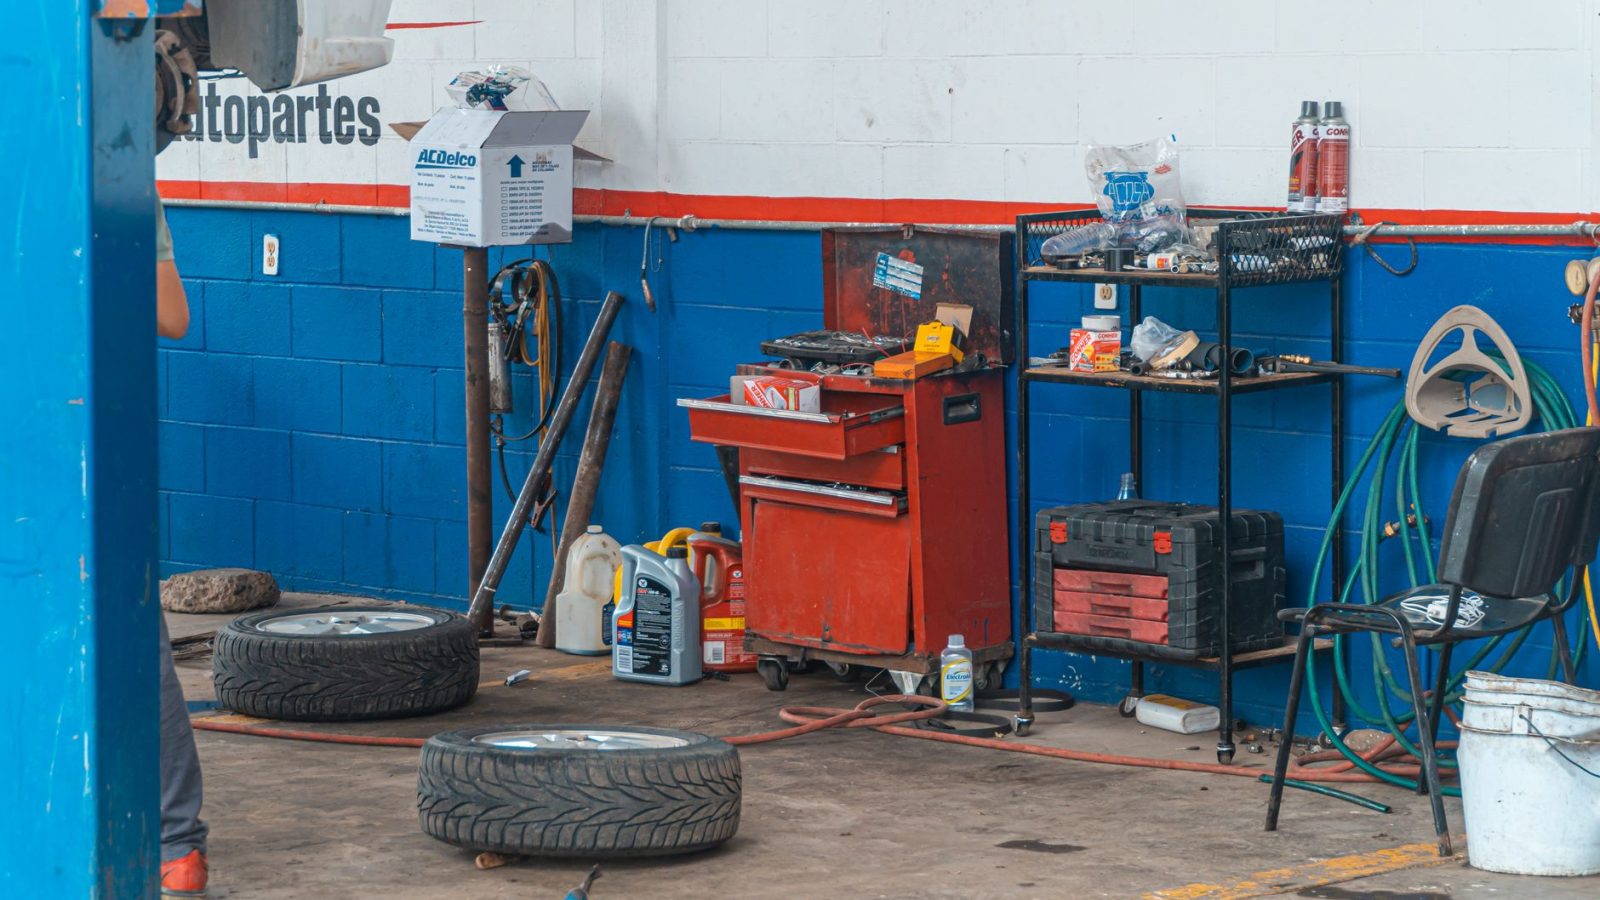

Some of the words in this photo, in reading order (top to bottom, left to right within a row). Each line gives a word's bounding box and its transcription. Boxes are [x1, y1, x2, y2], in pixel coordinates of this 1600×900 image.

[173, 83, 381, 158] utopartes
[417, 148, 477, 167] ACDelco
[751, 385, 769, 407] NHER
